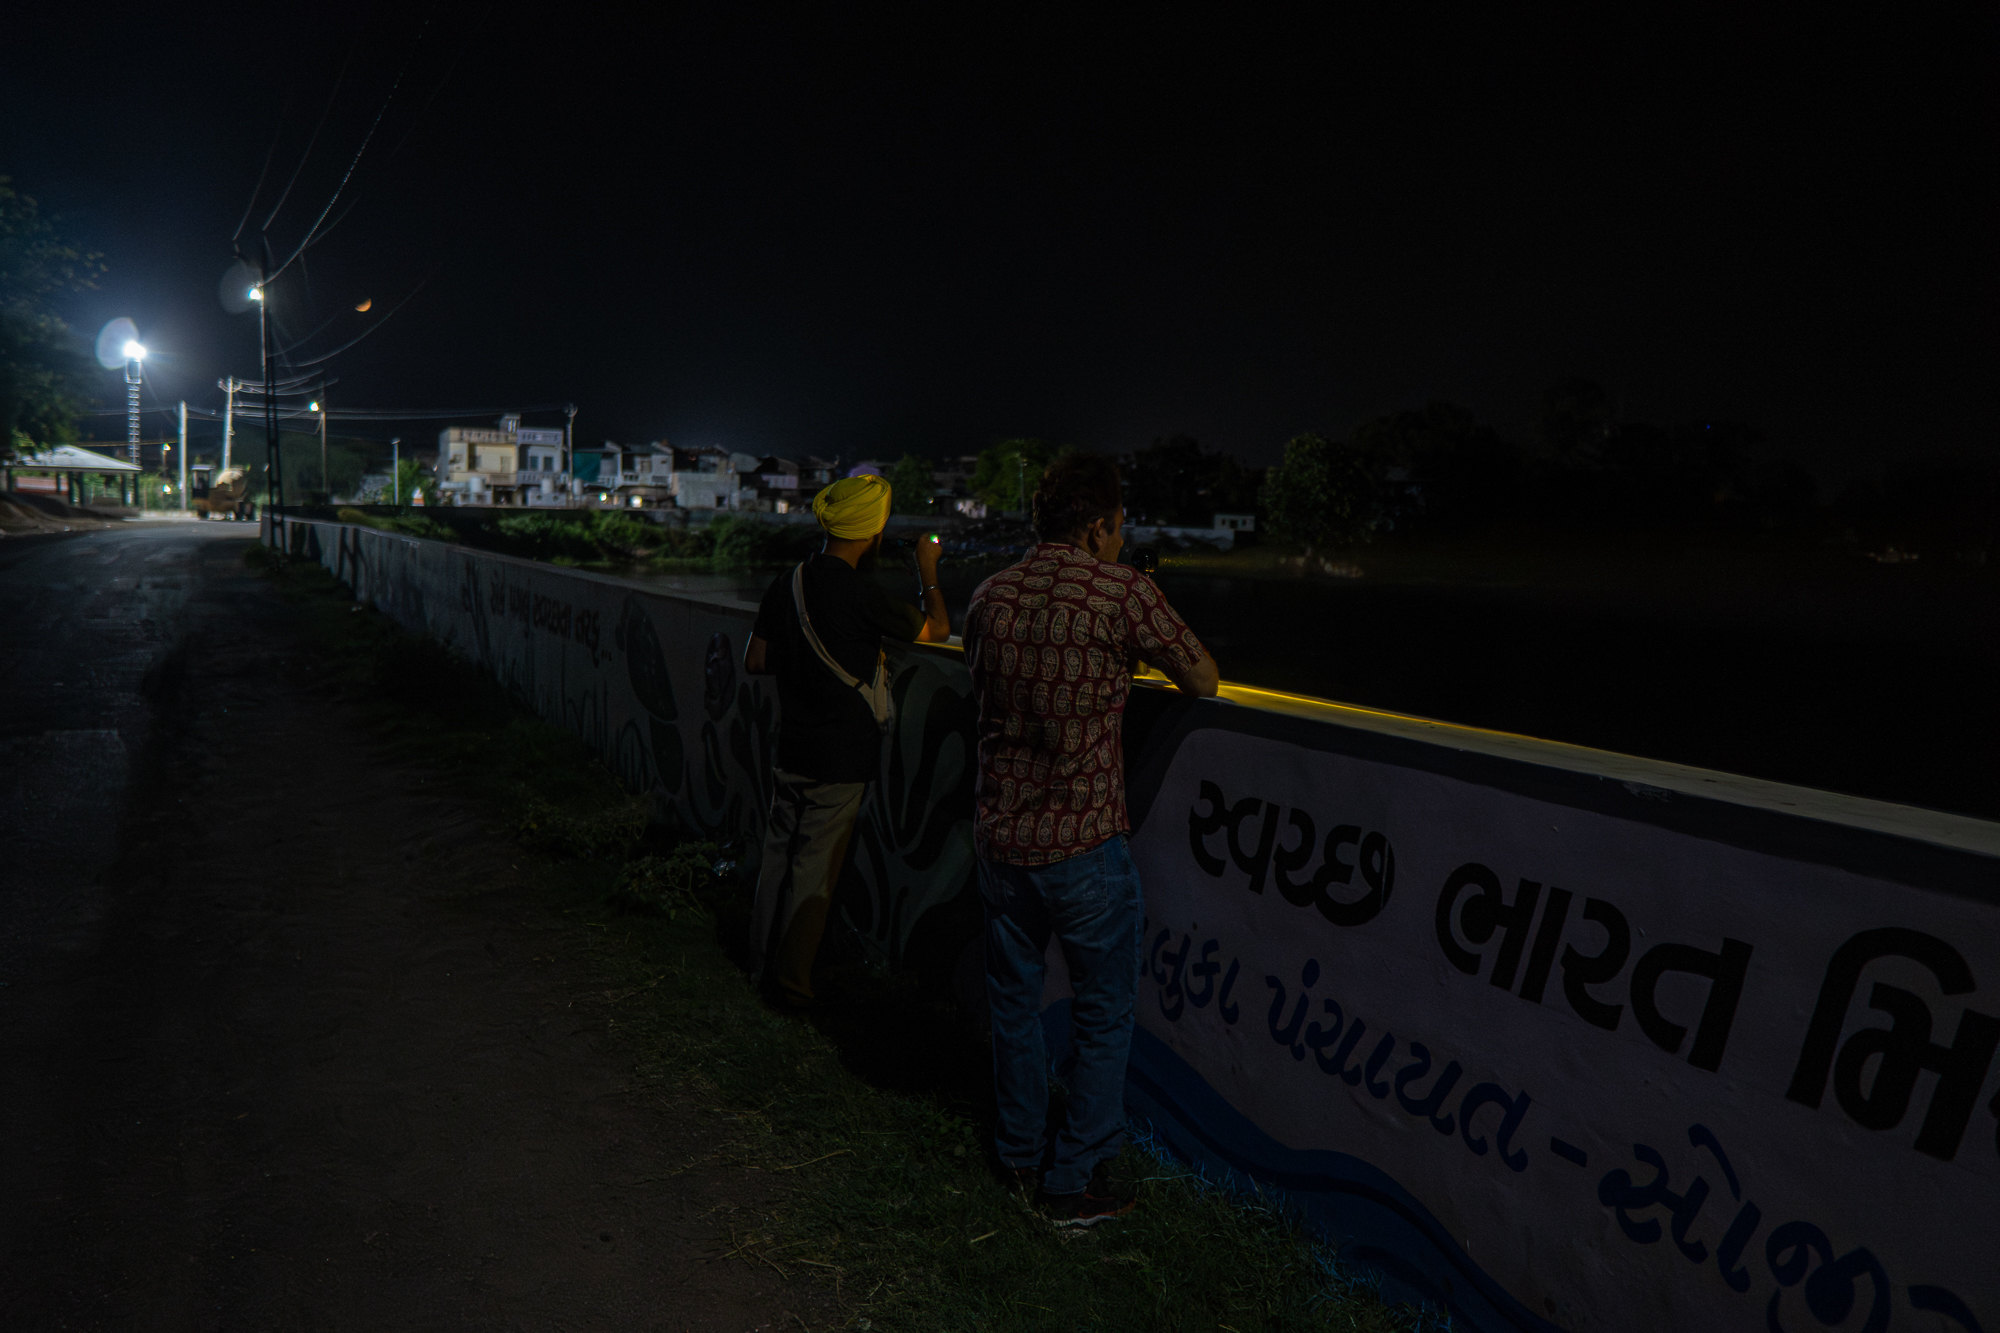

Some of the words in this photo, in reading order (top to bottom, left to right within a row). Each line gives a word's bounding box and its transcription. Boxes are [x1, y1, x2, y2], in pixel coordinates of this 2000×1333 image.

[1142, 916, 1241, 1026] લુકા
[1265, 957, 1532, 1173] પંચાયત
[1434, 862, 1754, 1072] ભારત
[1786, 926, 2000, 1162] મિ
